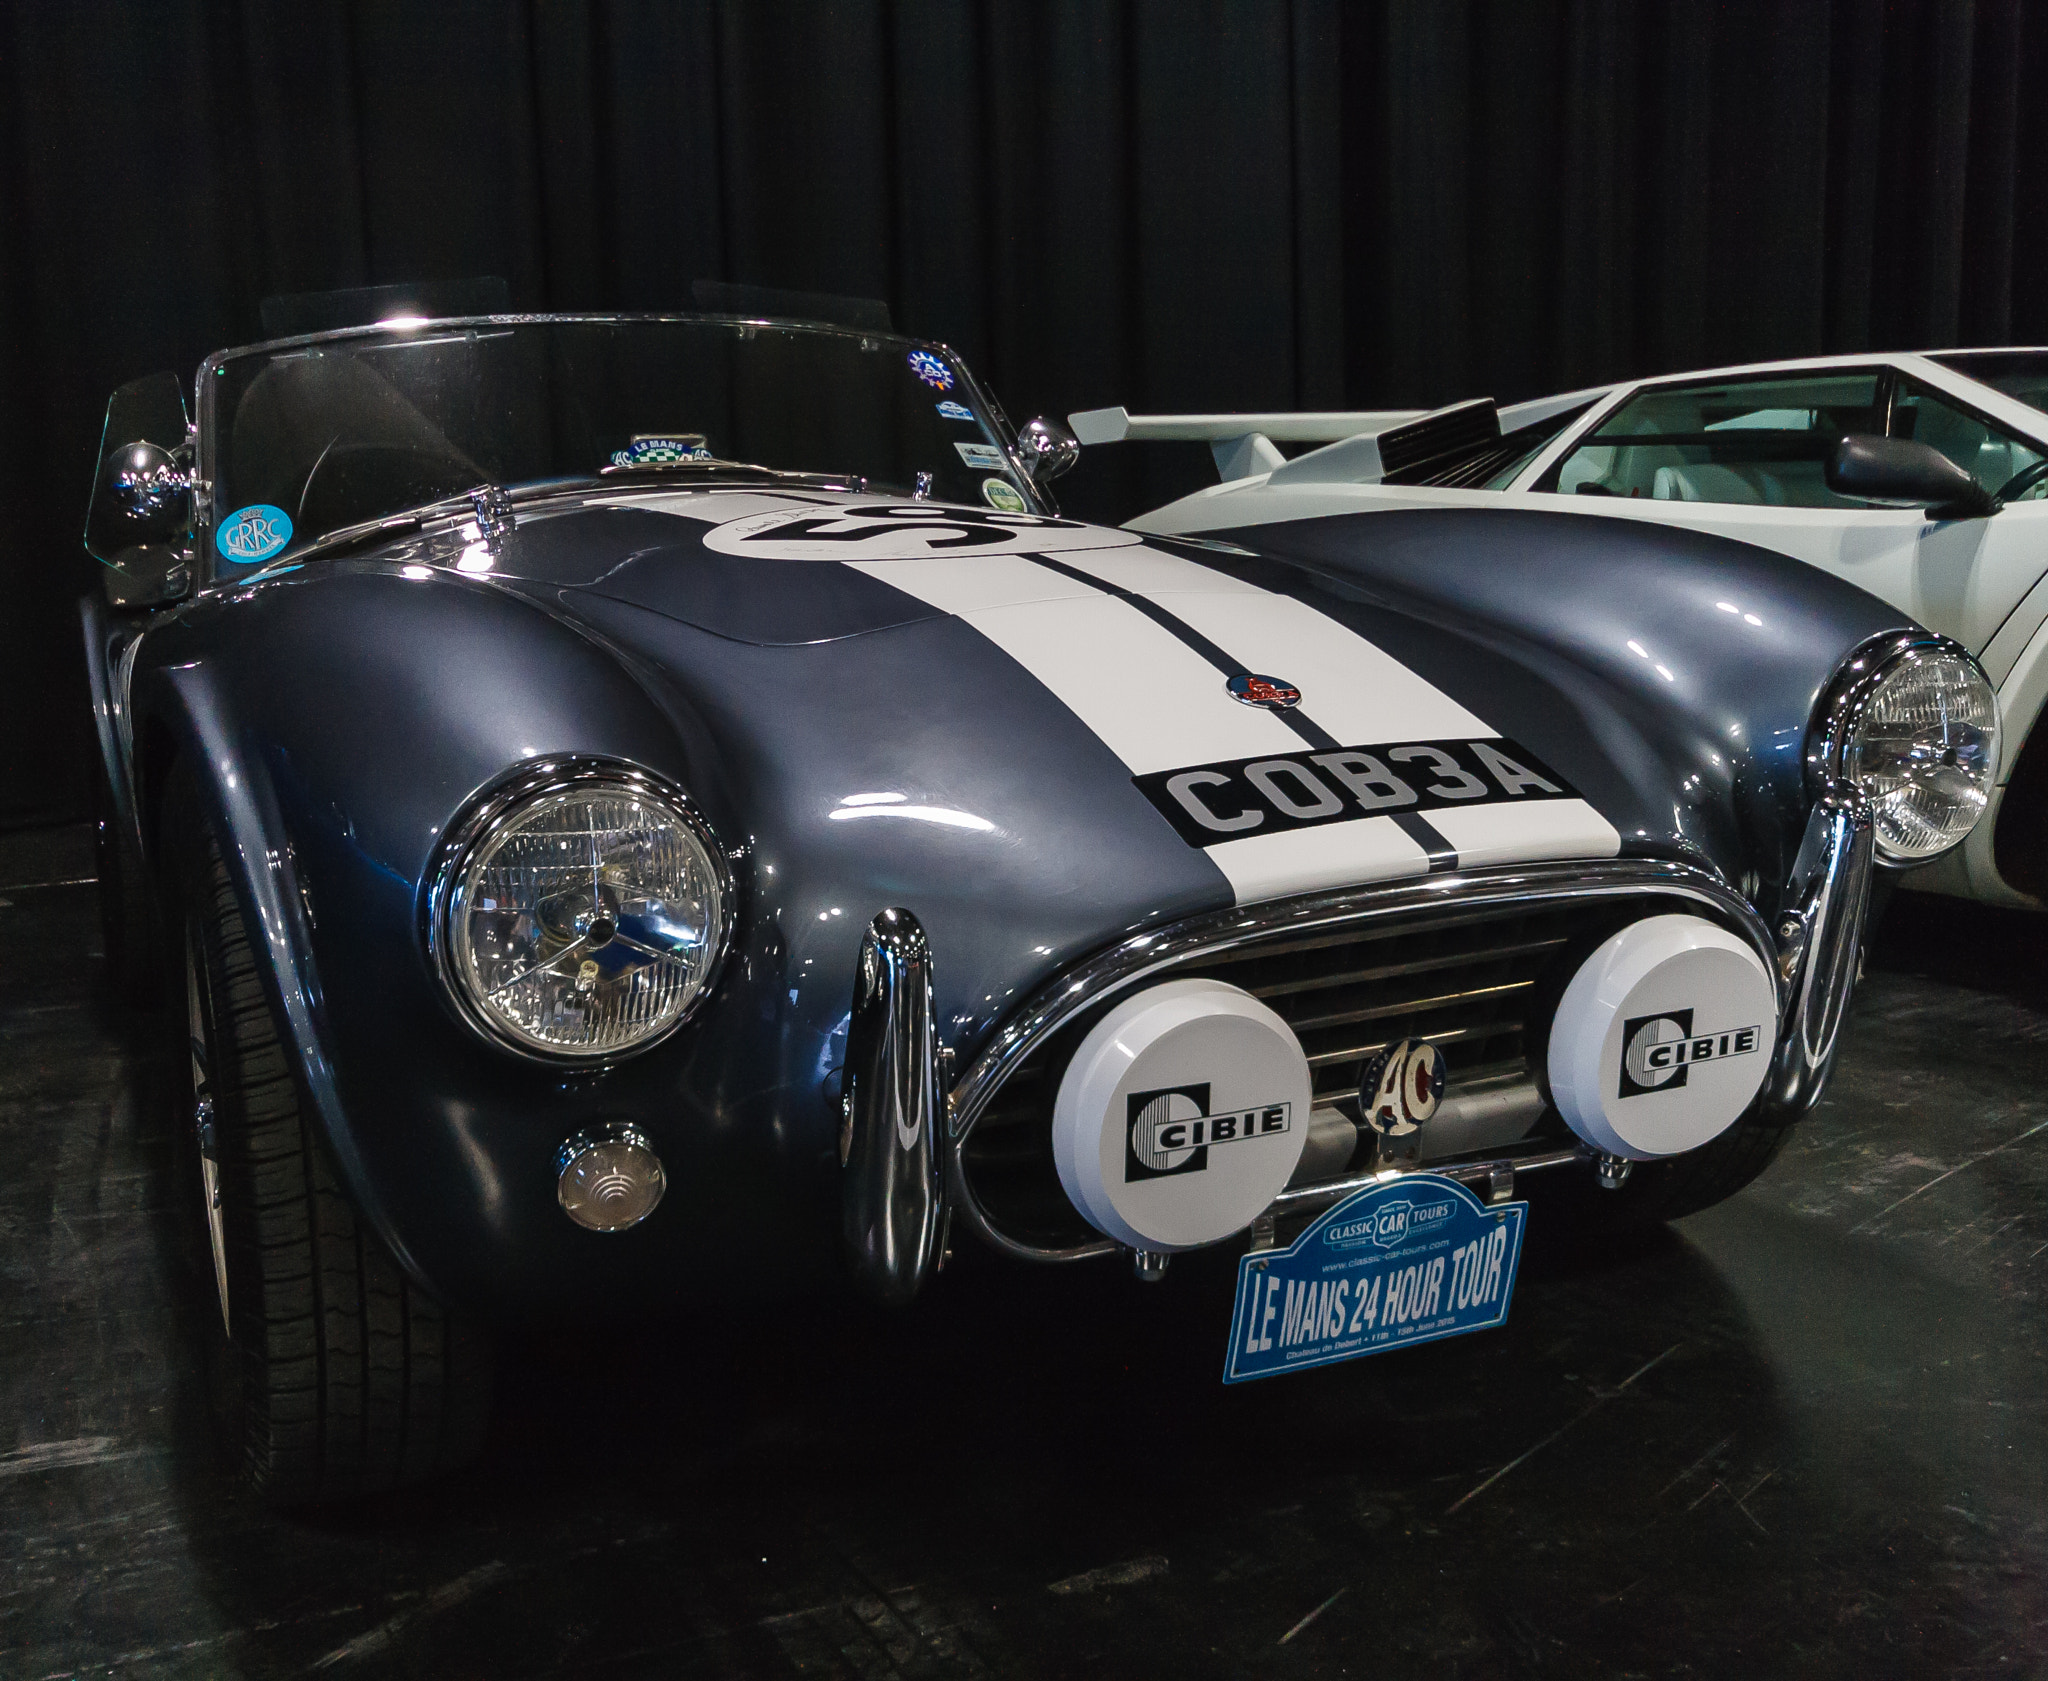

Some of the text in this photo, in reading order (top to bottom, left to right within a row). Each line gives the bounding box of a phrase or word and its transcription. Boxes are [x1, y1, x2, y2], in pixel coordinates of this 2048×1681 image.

[634, 440, 683, 453] LE MANS
[225, 518, 282, 551] GRRC
[1166, 743, 1564, 832] COB3A
[1365, 1040, 1436, 1136] AC
[1329, 1220, 1373, 1241] CLASSIC
[1379, 1213, 1405, 1235] CAR
[1413, 1204, 1449, 1223] TOURS
[1322, 1239, 1450, 1273] www.classic-car-tours.com
[1246, 1225, 1507, 1353] LE MANS 24 HOUR TOUR
